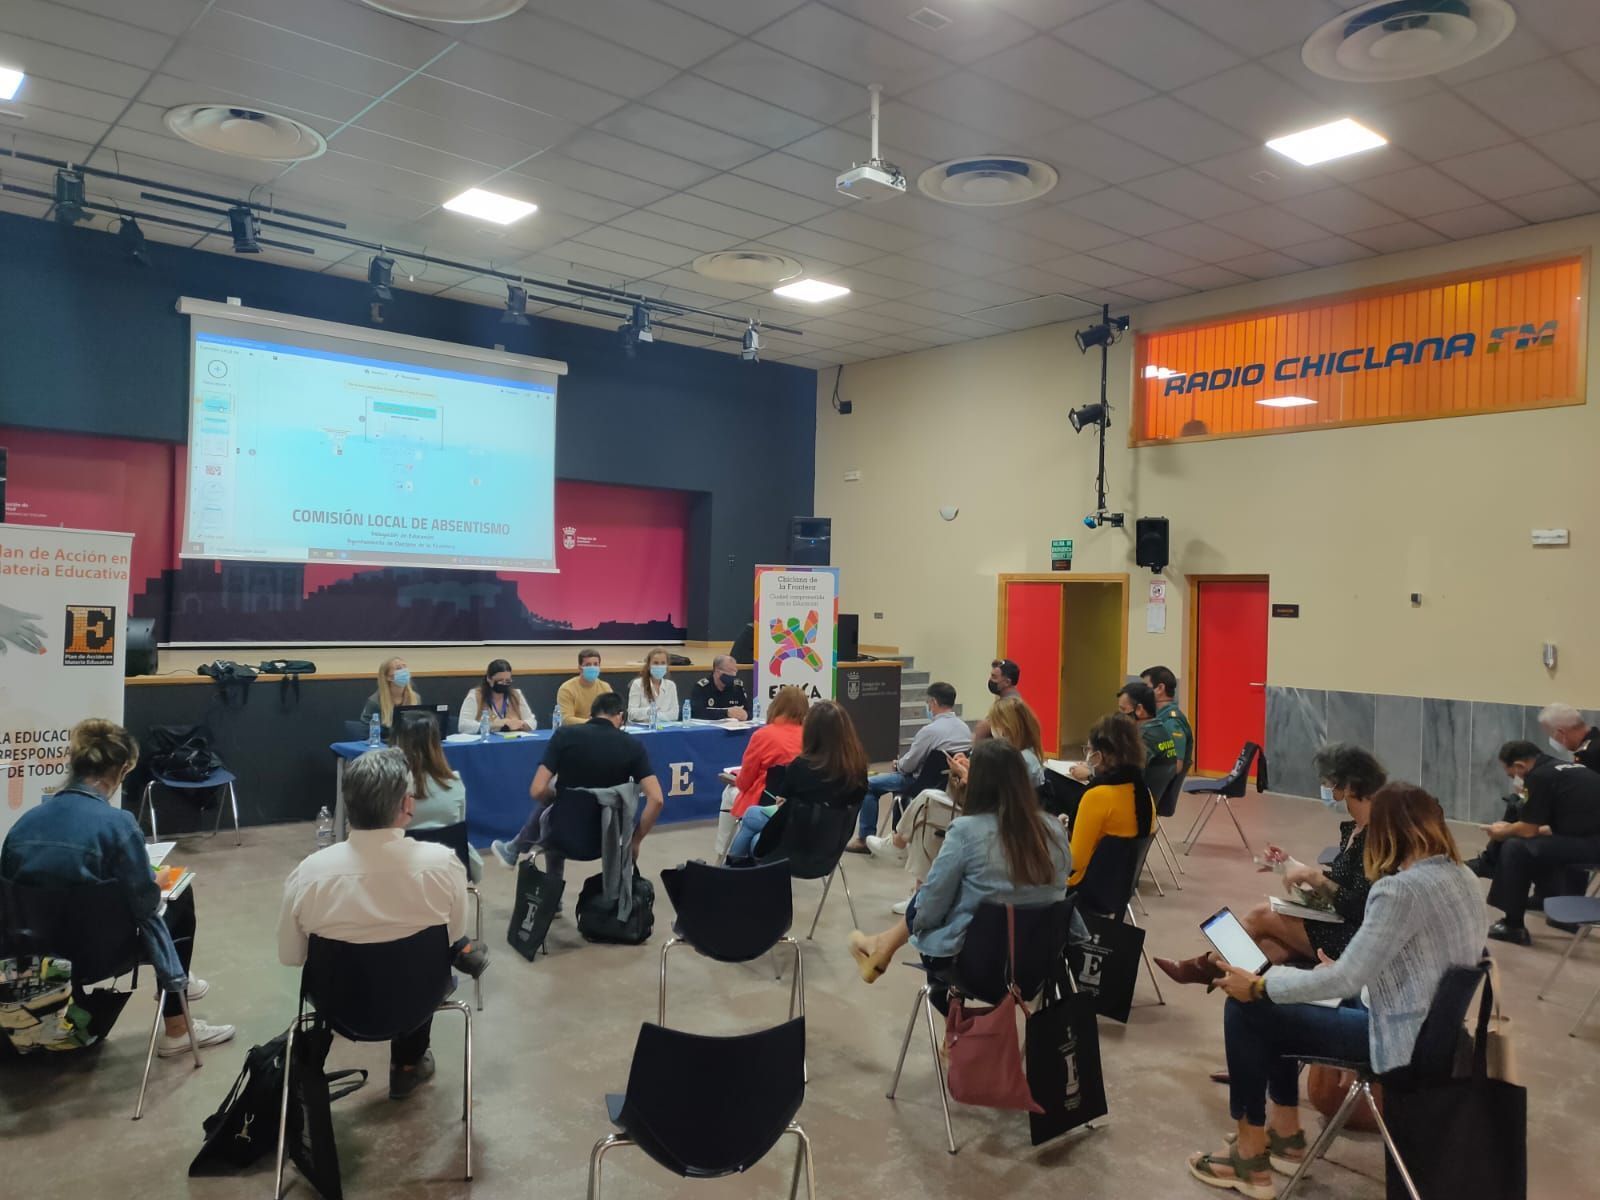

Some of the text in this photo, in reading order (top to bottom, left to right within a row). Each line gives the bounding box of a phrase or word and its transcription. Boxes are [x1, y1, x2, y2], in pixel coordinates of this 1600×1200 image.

[1164, 319, 1559, 397] RADIO CHICLANA FM
[292, 508, 511, 536] COMISIÓN LOCAL DE ABSENTISMO
[0, 544, 128, 564] lan de Acción en
[0, 564, 128, 580] ateria Educativa
[15, 729, 71, 744] EDUCACI
[7, 766, 25, 778] DE
[668, 761, 694, 797] E
[1079, 951, 1102, 986] E
